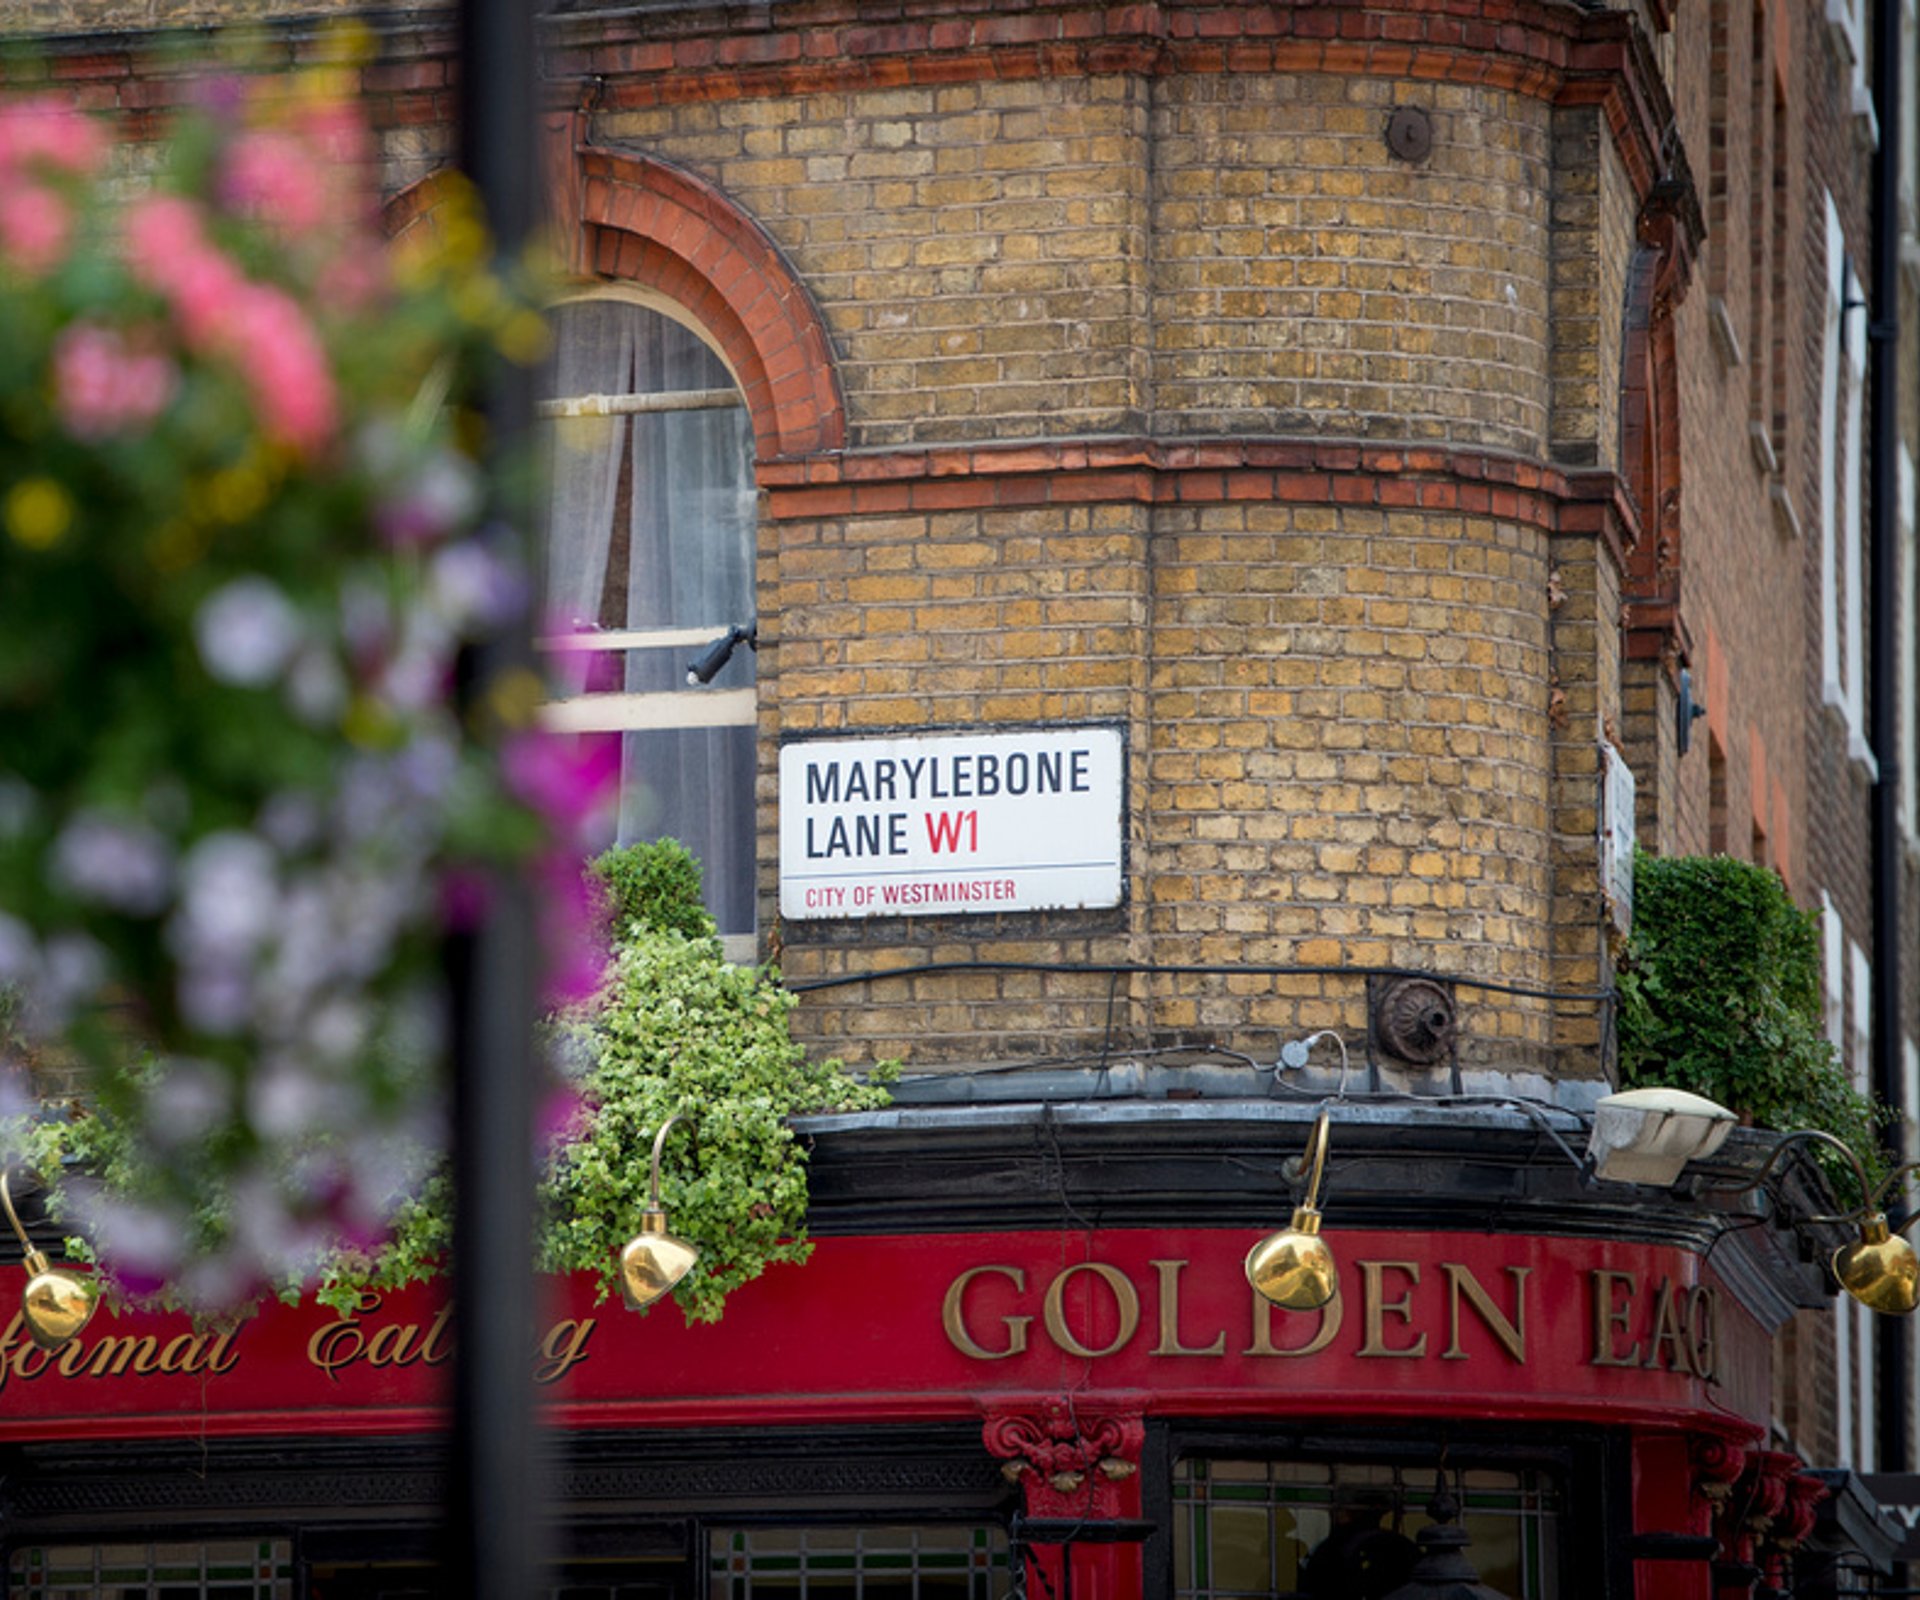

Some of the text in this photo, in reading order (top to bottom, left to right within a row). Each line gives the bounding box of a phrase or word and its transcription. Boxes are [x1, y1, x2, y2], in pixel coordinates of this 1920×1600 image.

[806, 750, 1090, 804] MARYLEBONE
[806, 810, 977, 859] LANE W1
[805, 879, 1016, 908] CITY OF WESTMINSTER
[307, 1292, 596, 1383] Eatg
[942, 1260, 1721, 1385] GOLDEN EAG
